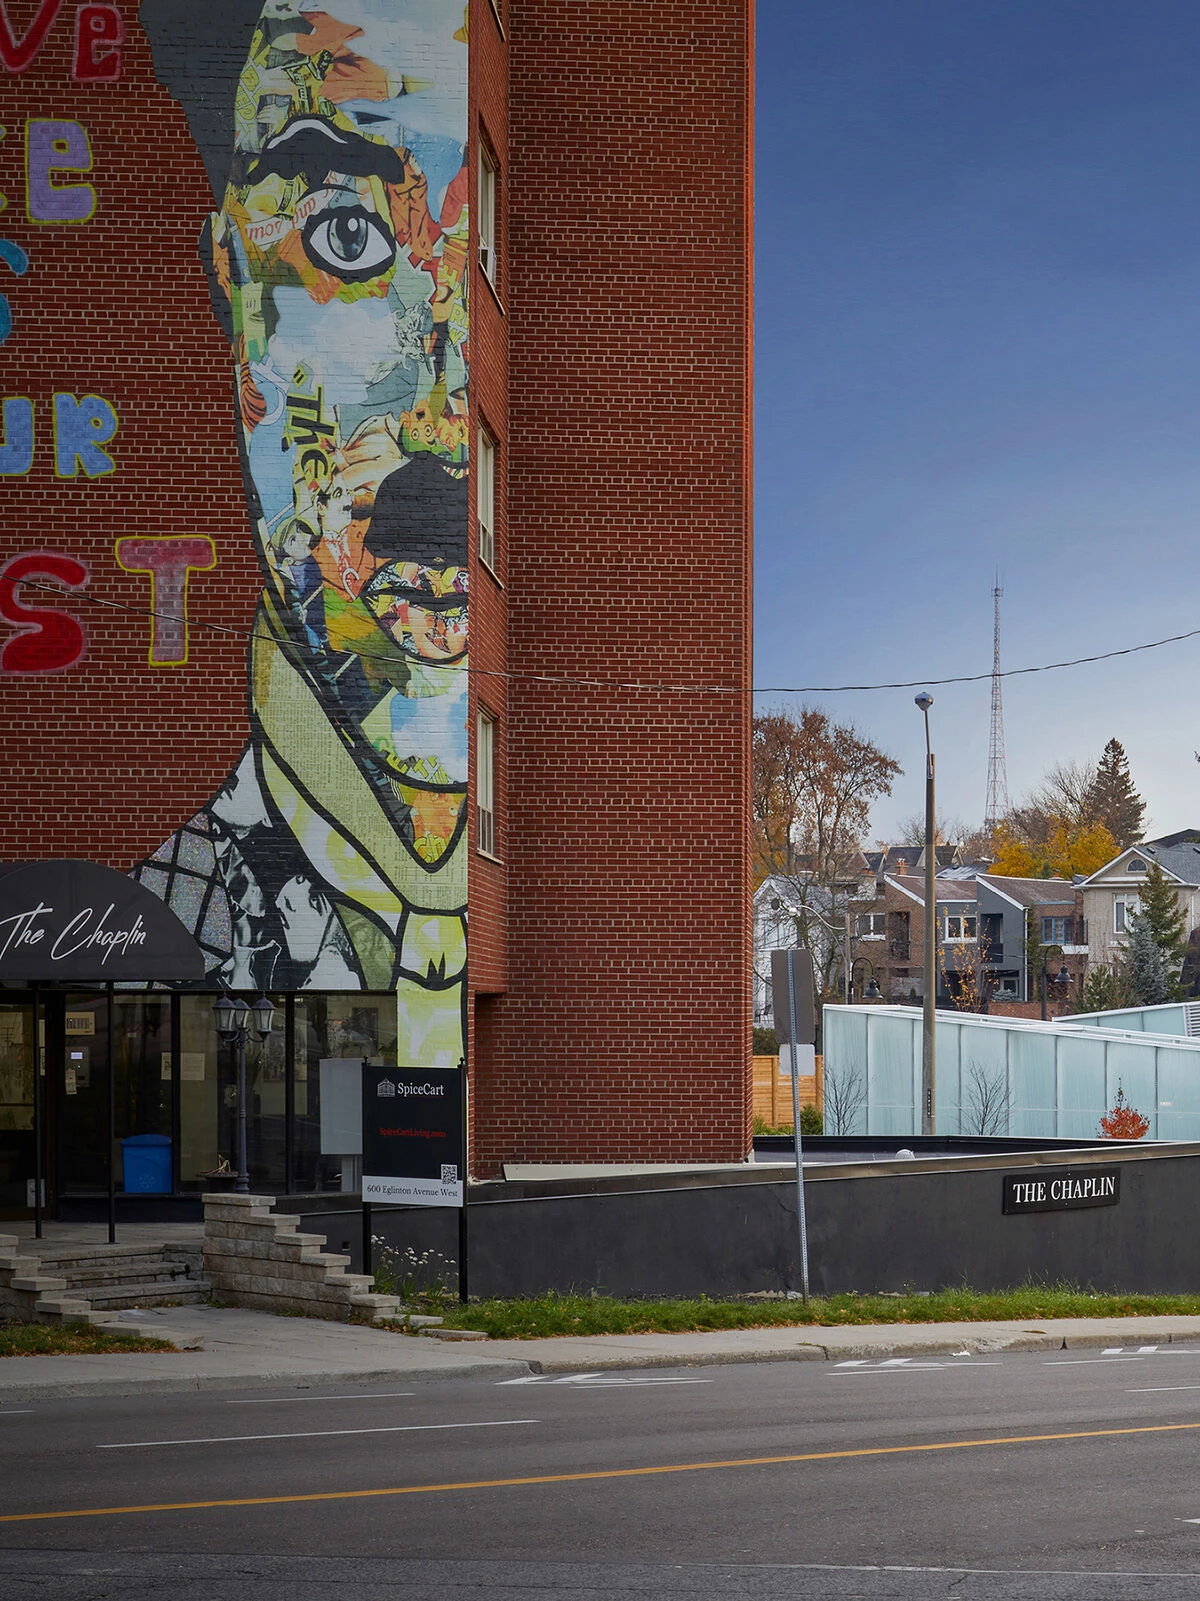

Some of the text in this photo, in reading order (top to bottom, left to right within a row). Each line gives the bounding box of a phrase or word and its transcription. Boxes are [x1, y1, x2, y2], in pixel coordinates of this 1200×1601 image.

[0, 902, 147, 965] The Chaplin
[398, 1082, 444, 1097] SpiceCart
[367, 1184, 458, 1197] 600 Eglinton Avenue West
[1013, 1177, 1115, 1203] THE CHAPLIN
